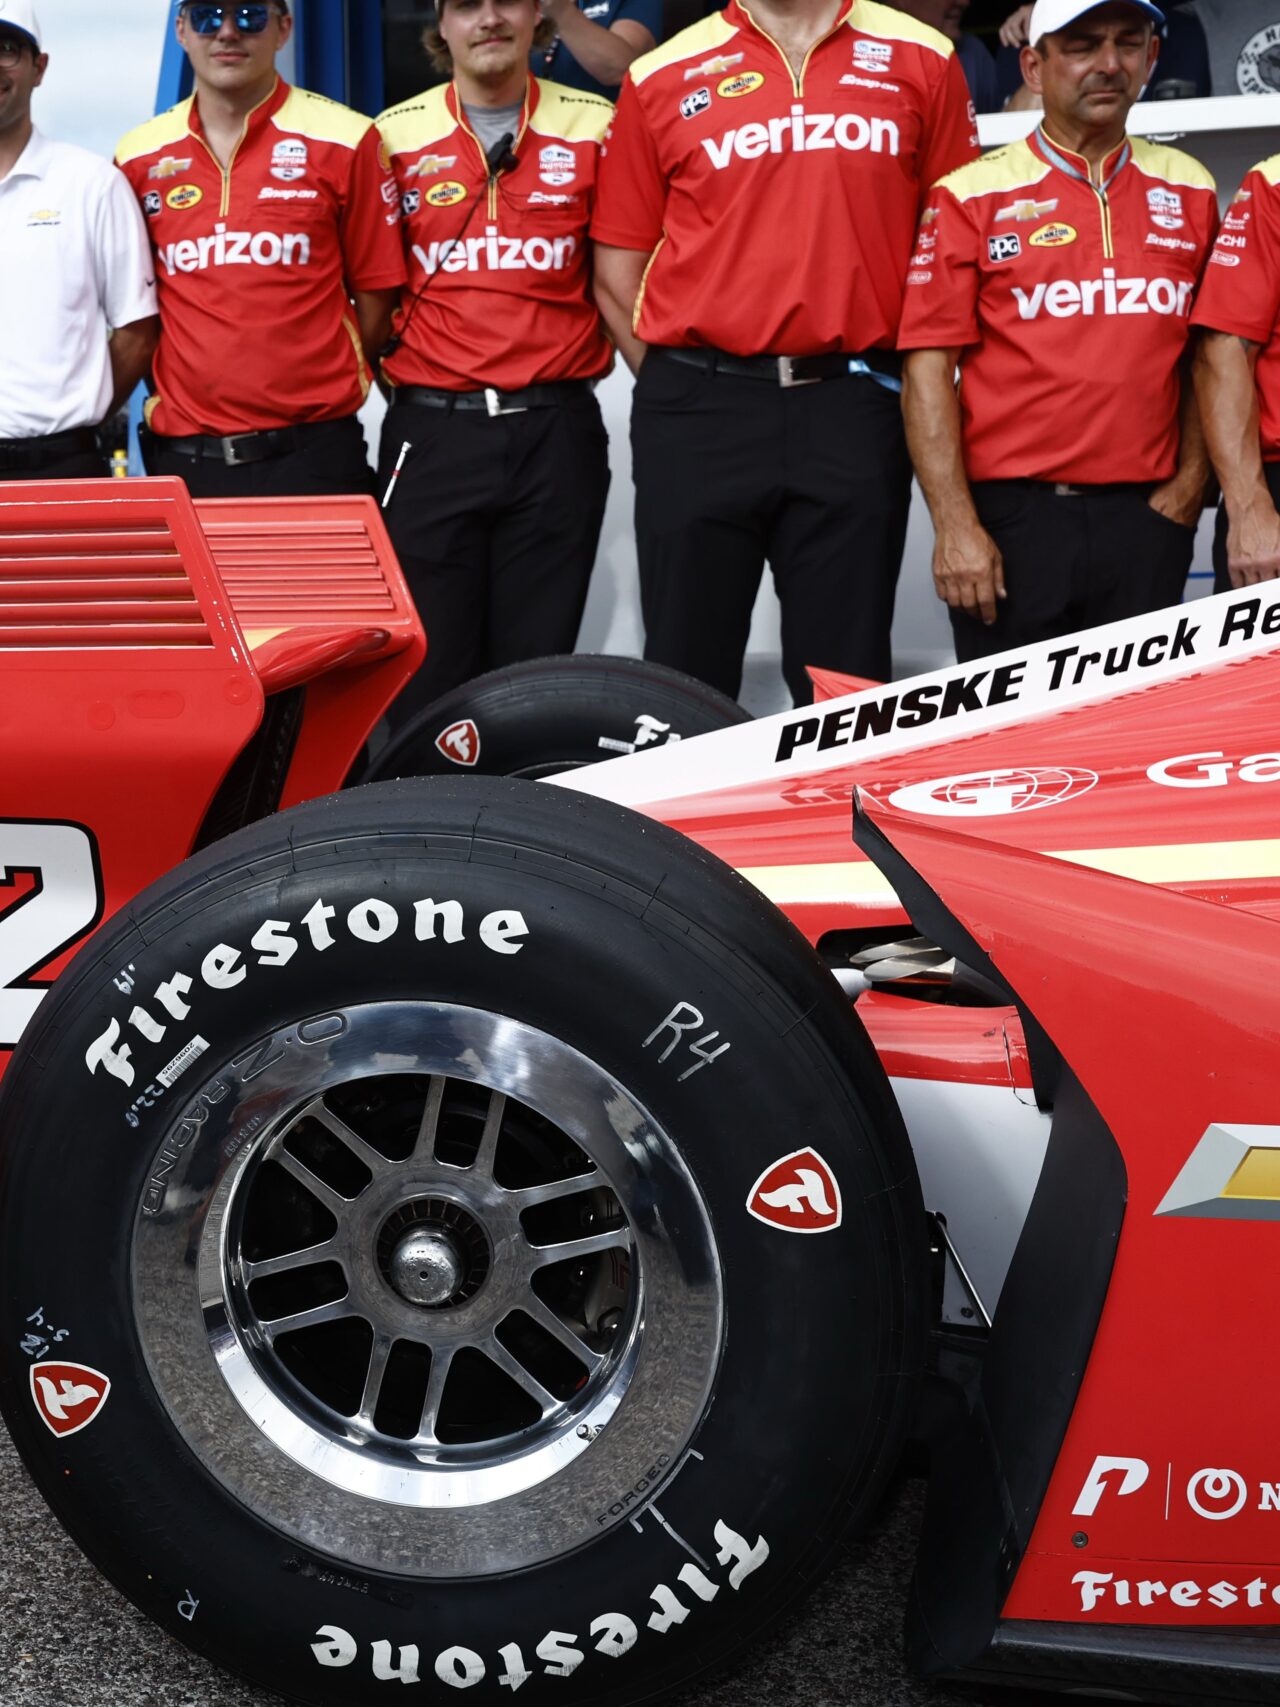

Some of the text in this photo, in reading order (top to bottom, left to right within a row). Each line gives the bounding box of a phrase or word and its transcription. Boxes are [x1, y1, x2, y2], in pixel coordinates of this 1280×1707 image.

[682, 89, 710, 117] PPG
[839, 74, 900, 92] Snap-on
[701, 104, 900, 170] verizon
[258, 187, 318, 201] Snap-on
[158, 223, 311, 275] verizon
[412, 225, 576, 274] verizon
[991, 235, 1019, 260] PPG
[1145, 233, 1197, 251] Snap-on
[1011, 268, 1194, 320] verizon
[775, 660, 1028, 763] PENSKE
[1047, 617, 1201, 691] Truck
[85, 898, 530, 1087] Firestone
[162, 1041, 196, 1077] 2096295
[641, 1001, 731, 1082] R4
[595, 1452, 671, 1529] FORGED
[310, 1518, 771, 1693] Firestone
[1071, 1570, 1280, 1612] Firest
